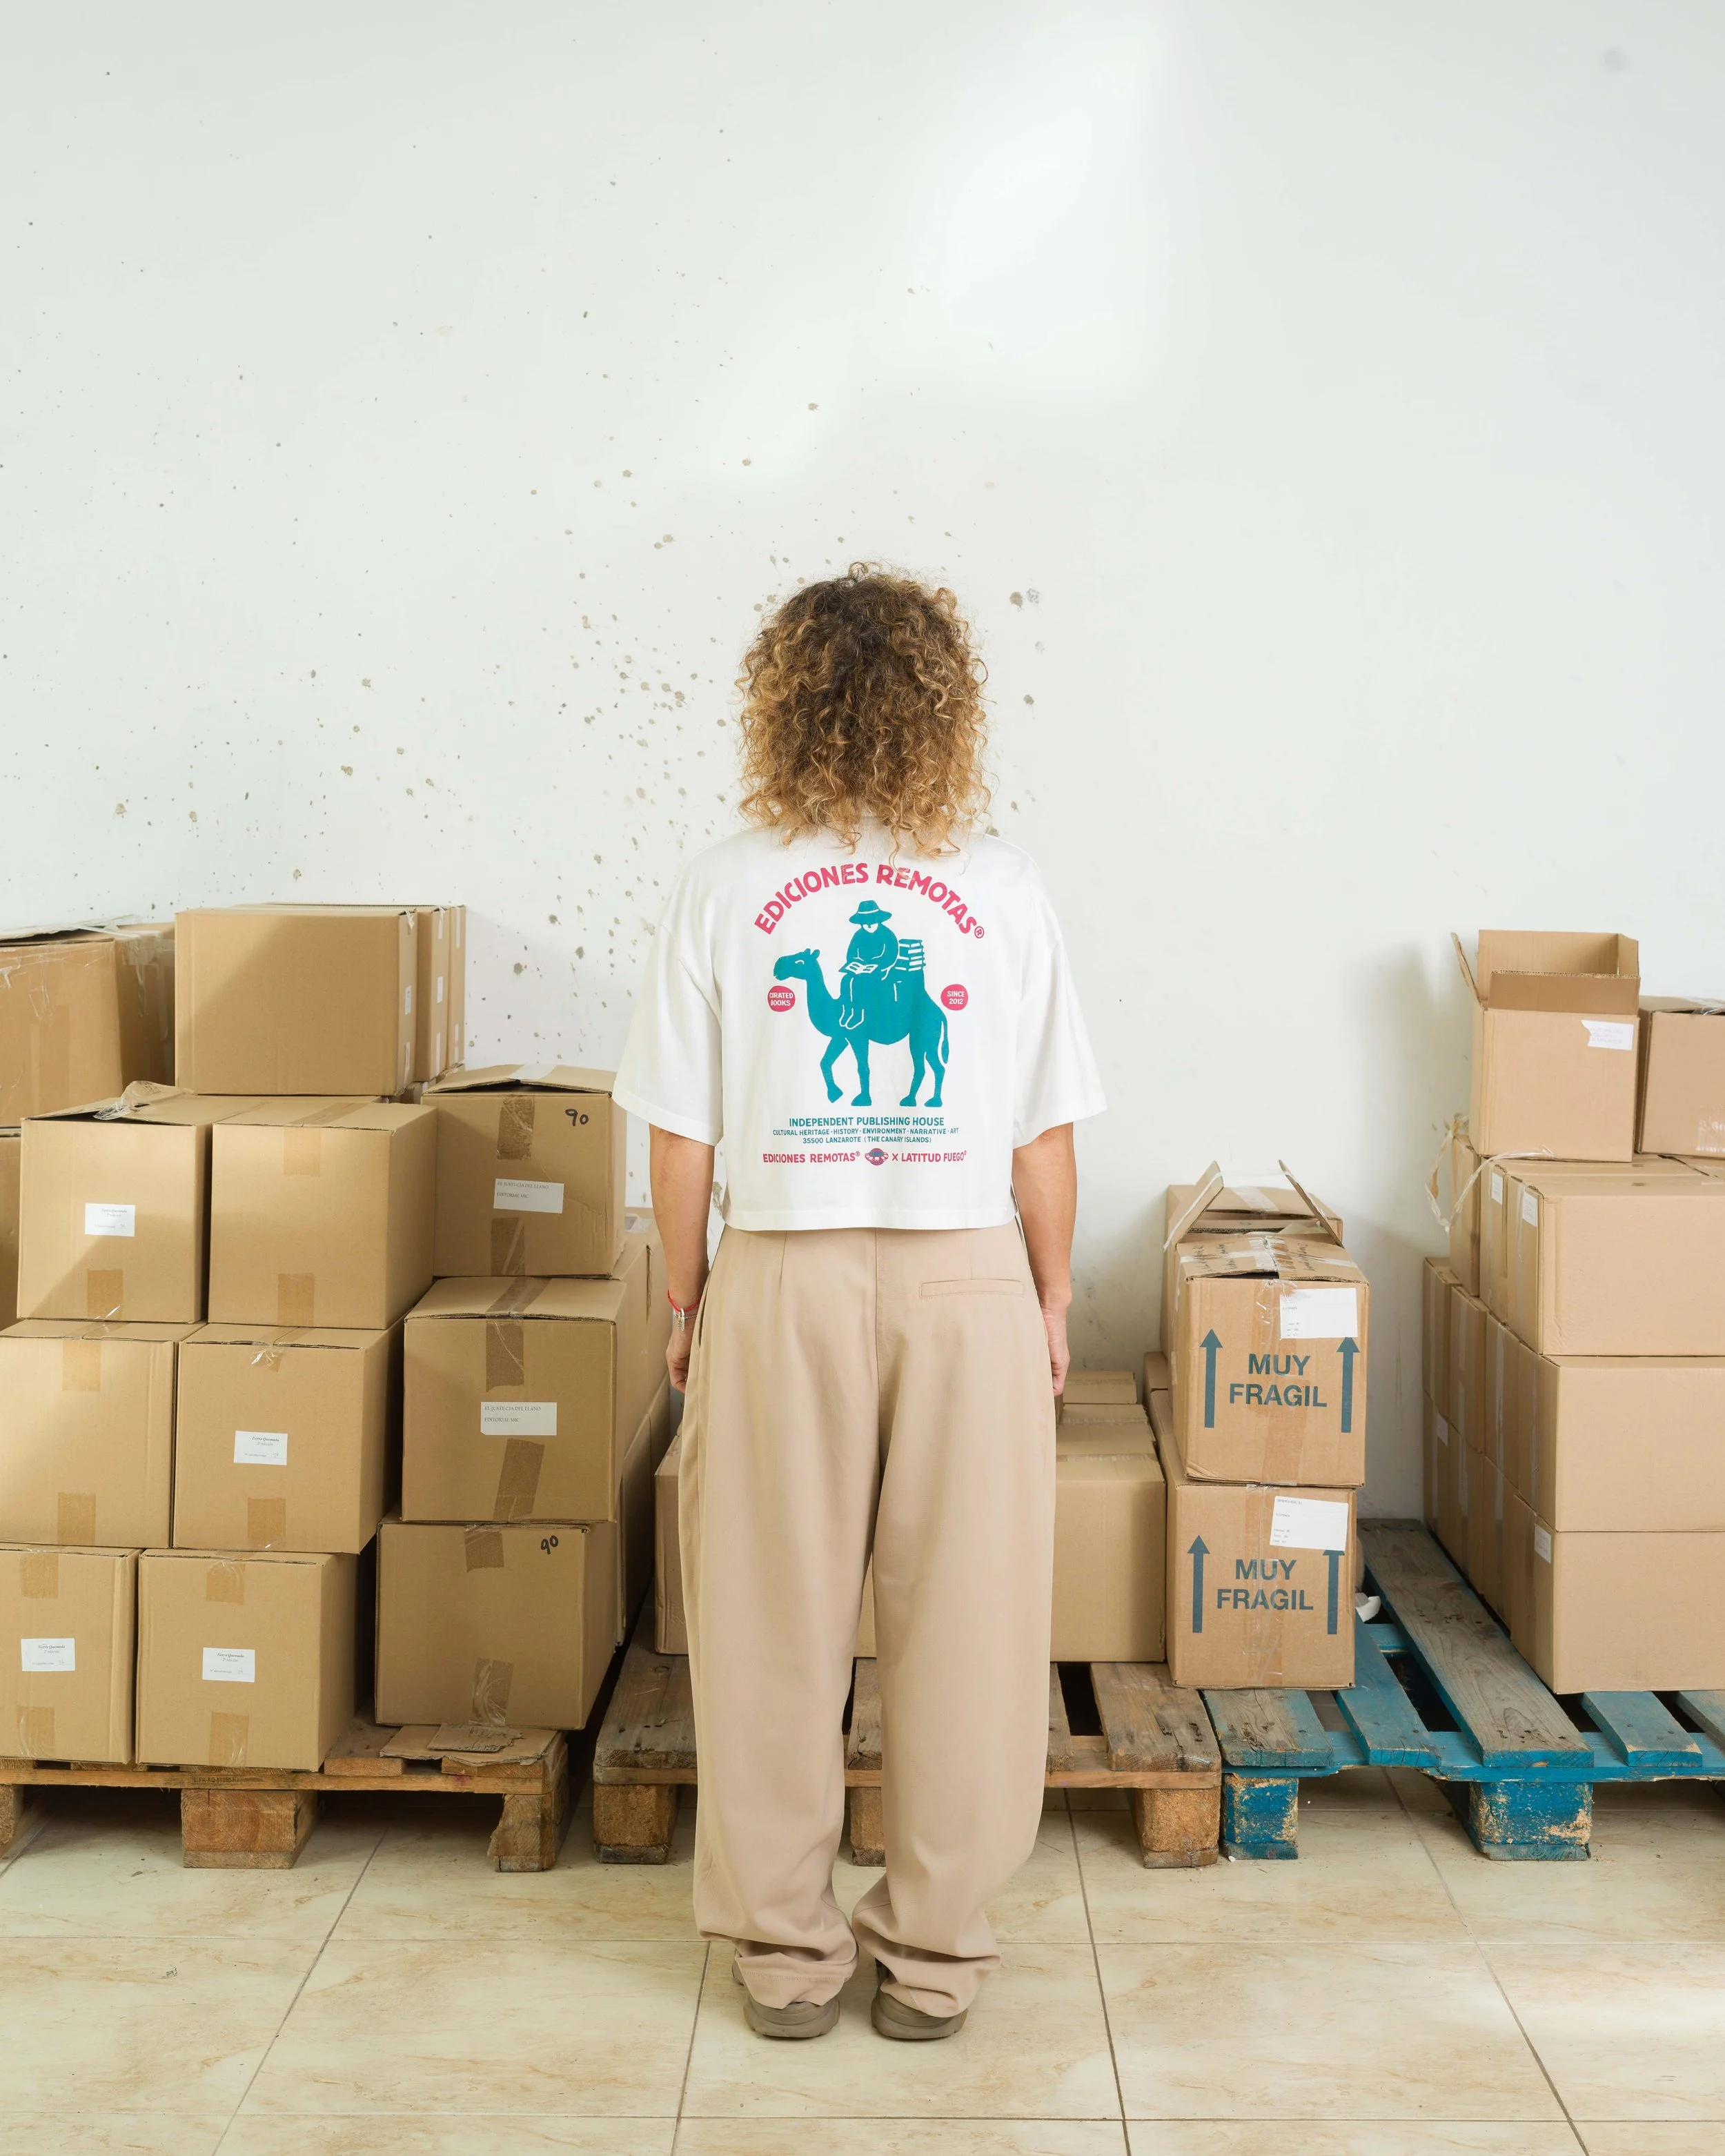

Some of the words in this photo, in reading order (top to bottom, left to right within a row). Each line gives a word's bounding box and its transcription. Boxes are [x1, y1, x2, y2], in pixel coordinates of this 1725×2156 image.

[754, 862, 869, 935] EDICIONES
[565, 1108, 589, 1127] 90
[789, 1117, 854, 1127] INDEPENDENT
[856, 1116, 911, 1126] PUBLISHING
[912, 1116, 945, 1127] HOUSE
[762, 1153, 806, 1163] EDICIONES
[901, 1153, 942, 1163] LATITUD
[1248, 1353, 1311, 1376] MUY
[1229, 1383, 1328, 1407] FRAGIL
[540, 1534, 559, 1555] 90
[1235, 1559, 1297, 1581] MUY
[1216, 1588, 1314, 1610] FRAGIL
